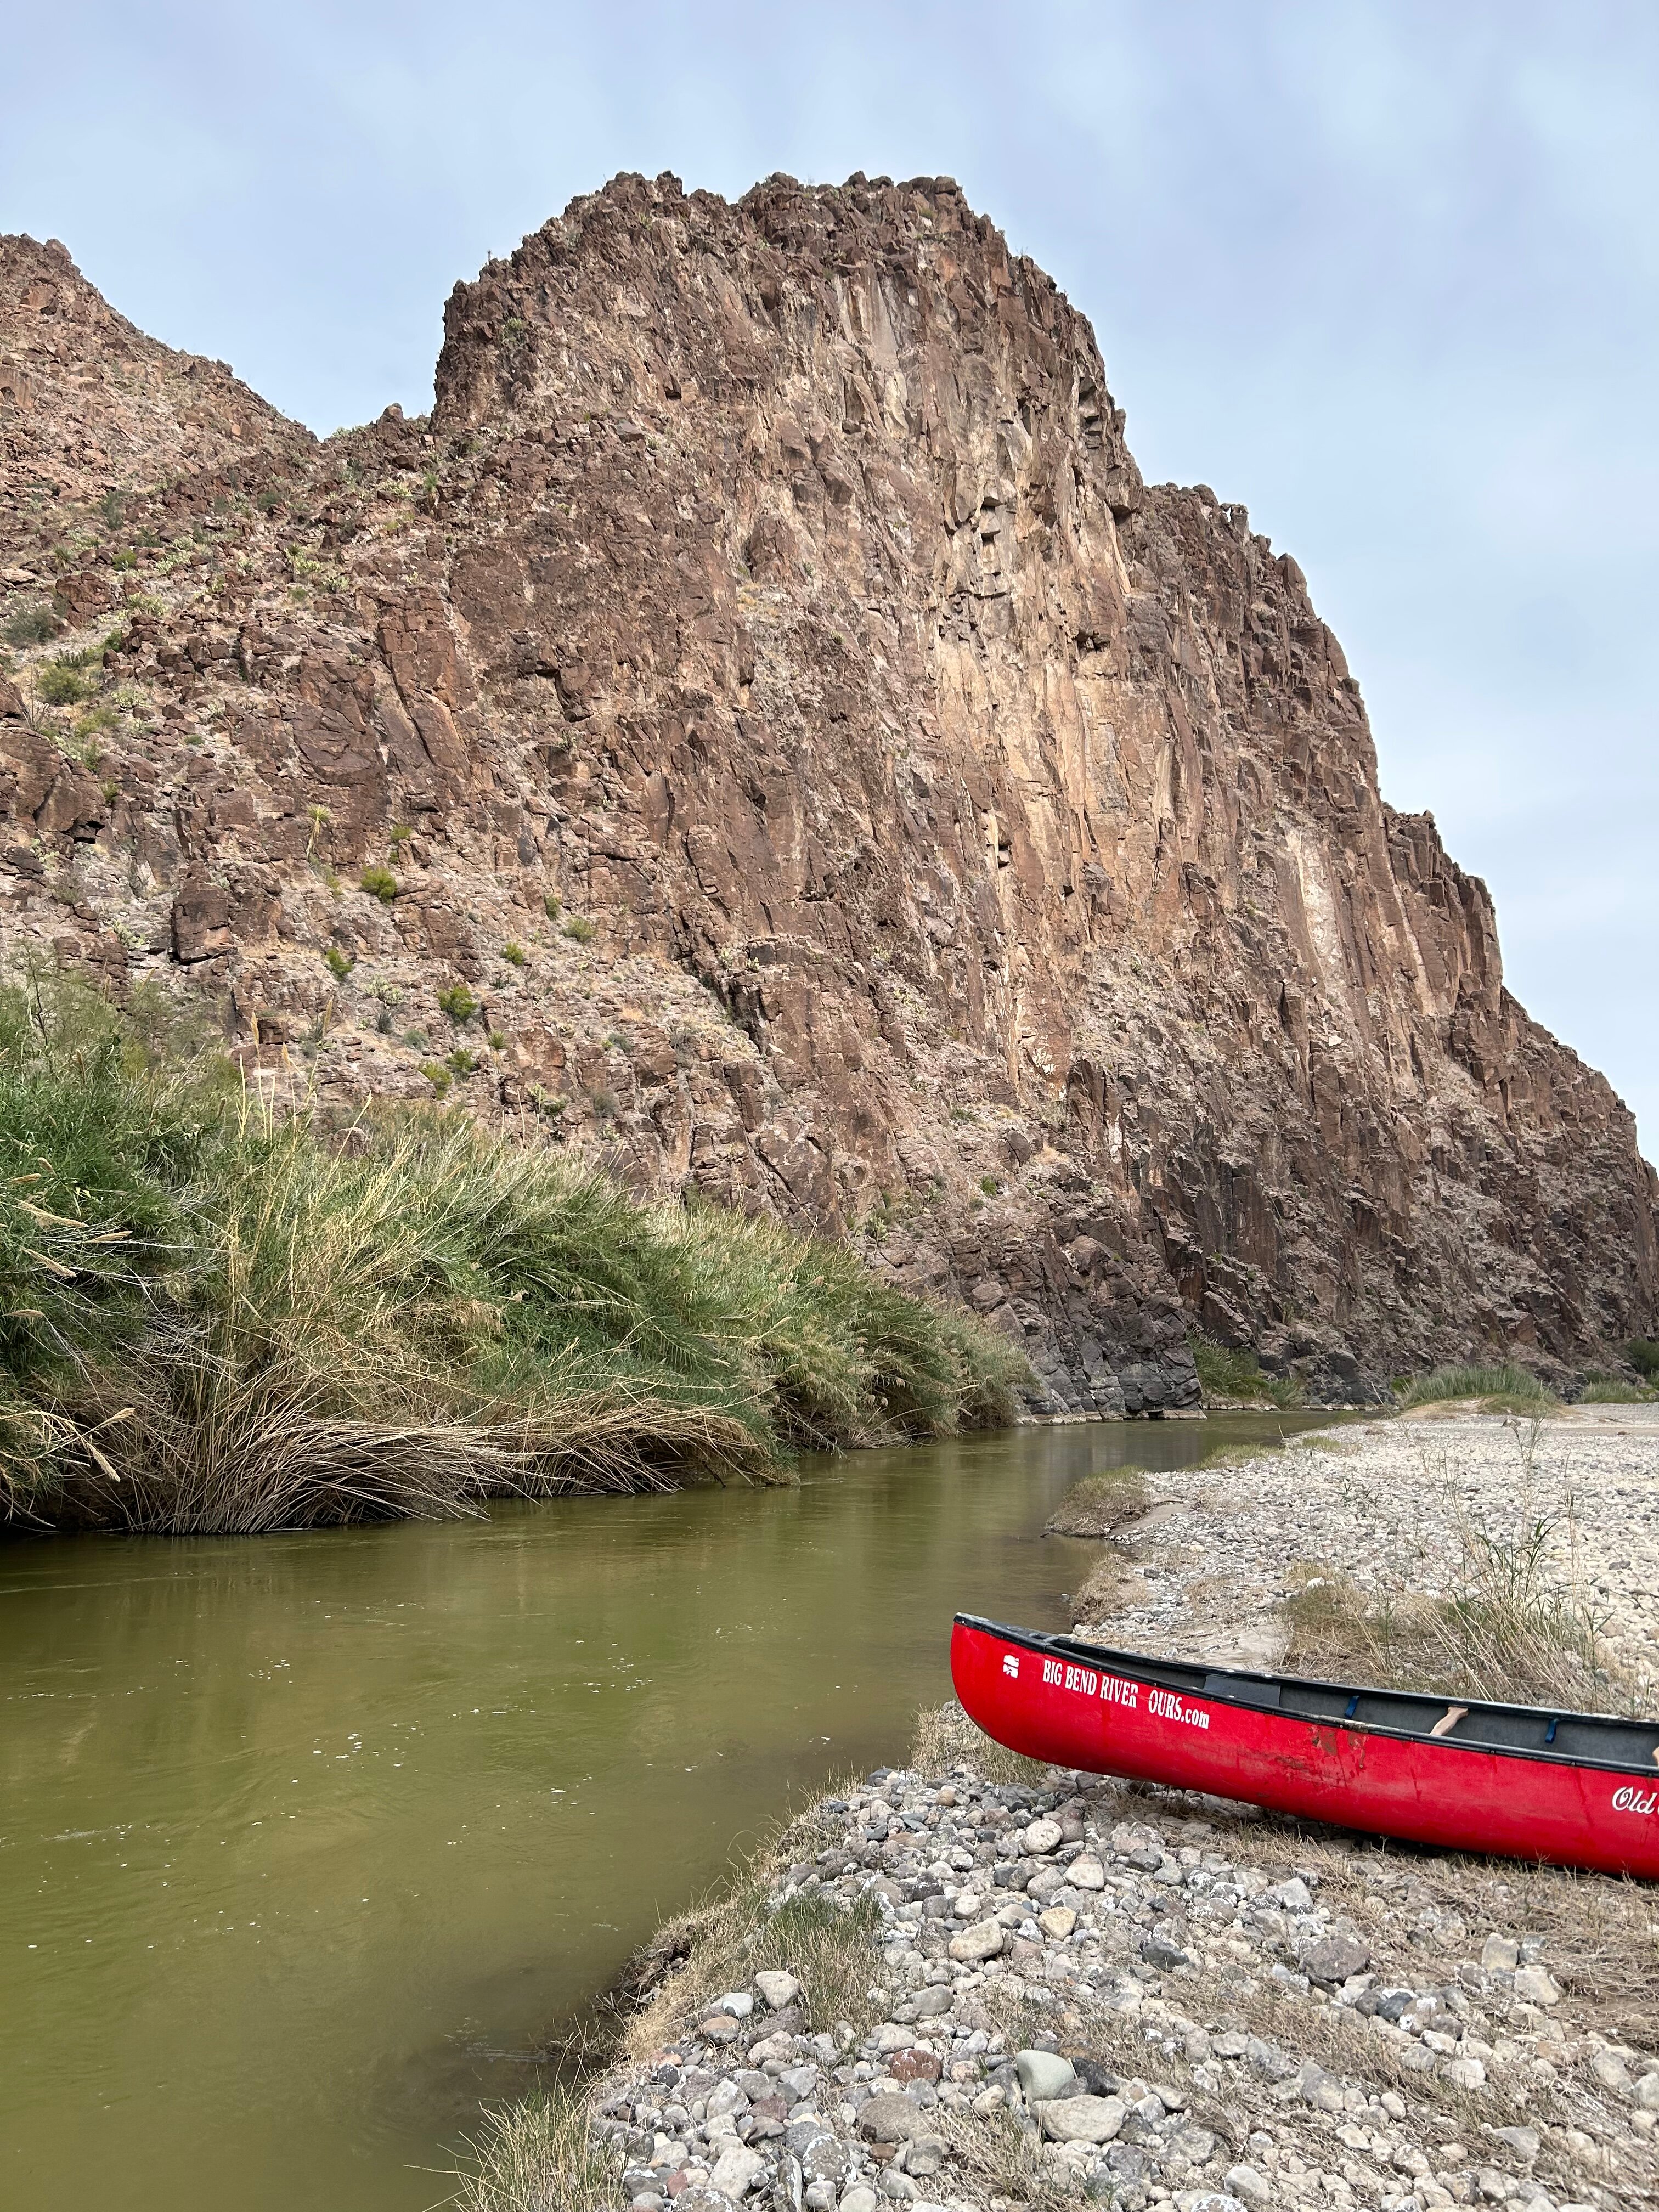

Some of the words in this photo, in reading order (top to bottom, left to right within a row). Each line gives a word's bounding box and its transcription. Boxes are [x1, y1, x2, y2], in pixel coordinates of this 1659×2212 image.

[1043, 1660, 1062, 1686] BIG
[1065, 1666, 1097, 1695] BEND
[1100, 1675, 1138, 1708] RIVER
[1612, 1786, 1657, 1814] Old
